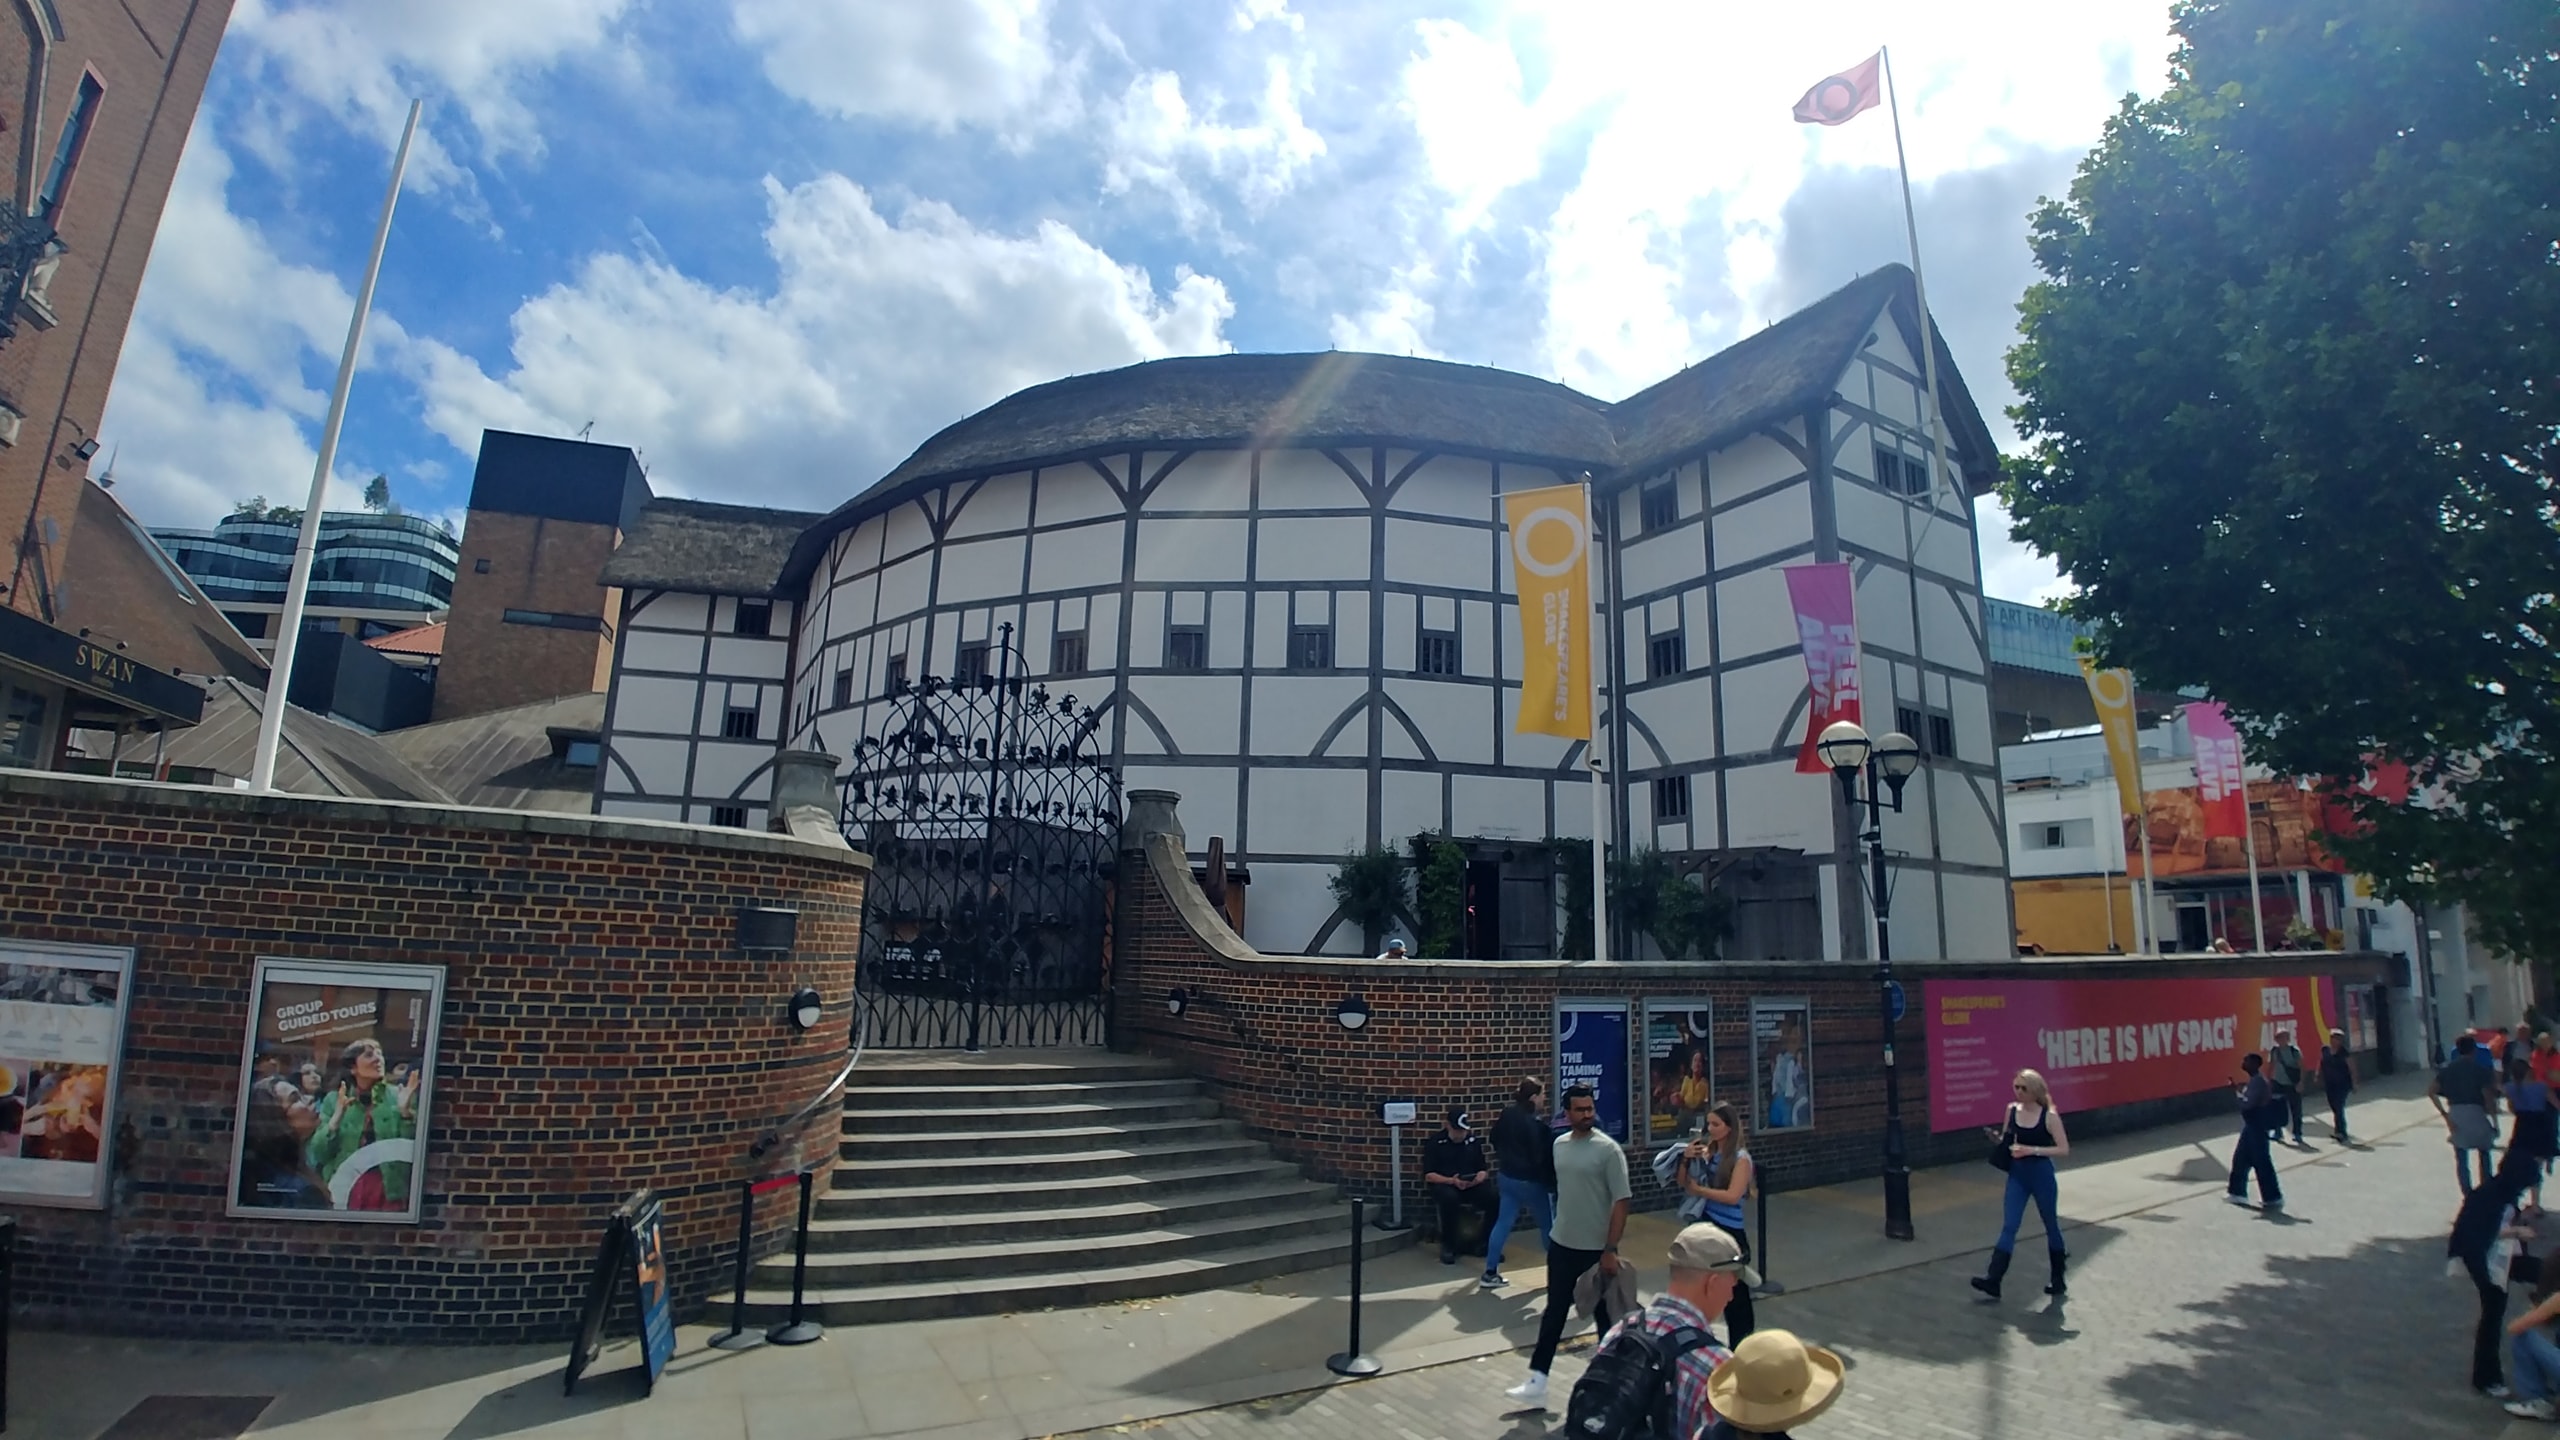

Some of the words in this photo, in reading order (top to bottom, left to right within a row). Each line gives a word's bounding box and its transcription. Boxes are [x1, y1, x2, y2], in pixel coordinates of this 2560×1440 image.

[1543, 592, 1556, 646] GLOBE
[2001, 607, 2021, 625] ART
[2027, 612, 2061, 632] FROM
[76, 644, 136, 683] SWAN
[1555, 588, 1569, 721] SHAKESPEARE'S
[1798, 613, 1830, 718] ALIVE
[1829, 624, 1858, 712] FEEL
[2193, 735, 2221, 801] ALIVE
[2216, 738, 2241, 797] FEEL
[276, 1000, 323, 1018] GROUP
[278, 1011, 331, 1031] GUIDED
[330, 1002, 377, 1020] TOURS
[2261, 986, 2294, 1015] FEEL
[1561, 1052, 1583, 1063] THE
[2115, 1025, 2138, 1062] IS
[2142, 1022, 2174, 1059] MY
[1561, 1064, 1603, 1076] TAMING
[1561, 1078, 1577, 1089] OF
